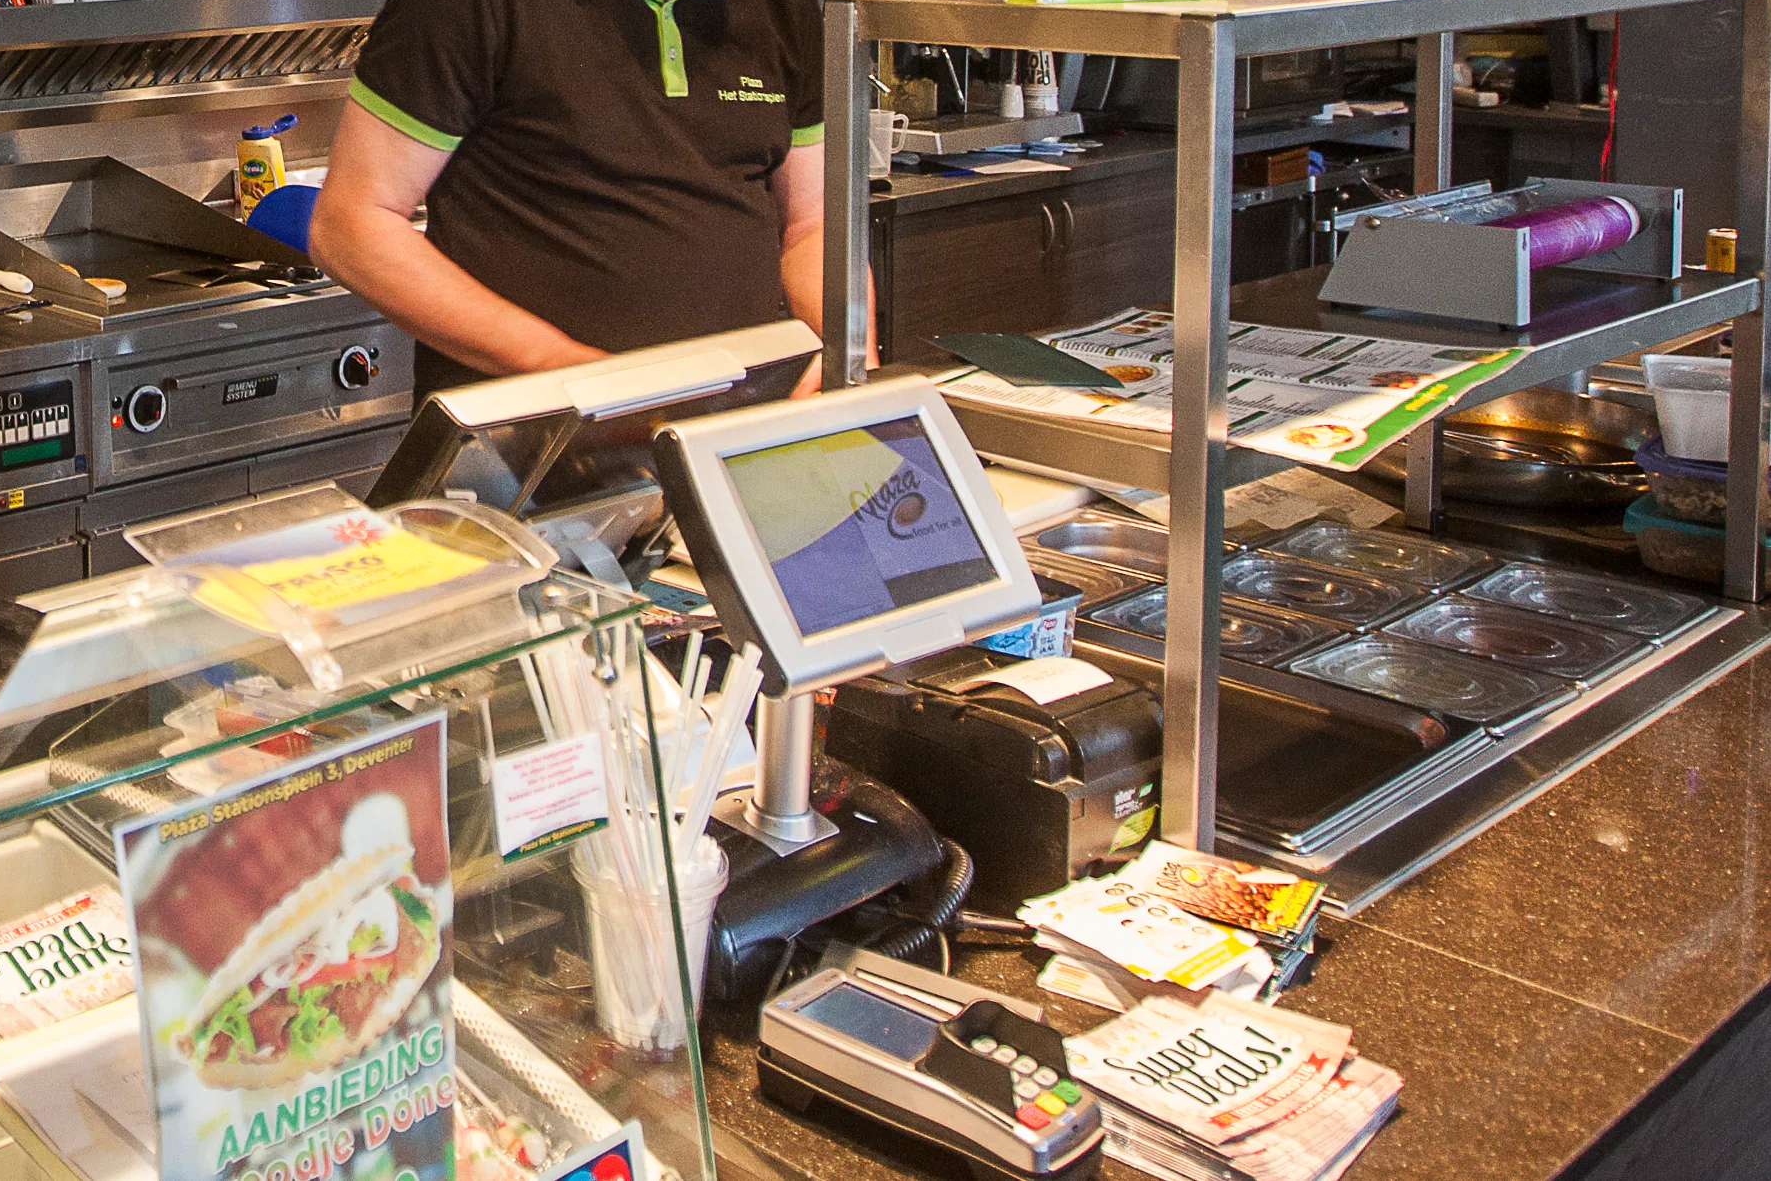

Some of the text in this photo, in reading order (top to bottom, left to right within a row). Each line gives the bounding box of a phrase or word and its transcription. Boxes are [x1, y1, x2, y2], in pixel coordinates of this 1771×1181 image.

[717, 90, 738, 102] Het
[226, 390, 257, 402] SYSTEM
[234, 379, 258, 392] MENU
[849, 469, 921, 523] Plaza
[911, 516, 963, 537] food for all
[159, 735, 415, 844] Plaza Stationsplein 3, Deventer
[20, 931, 134, 997] Super
[1102, 1026, 1214, 1089] Super
[1160, 1025, 1293, 1106] Deals!
[215, 1025, 444, 1175] AANBIEDING
[364, 1074, 455, 1150] Döne
